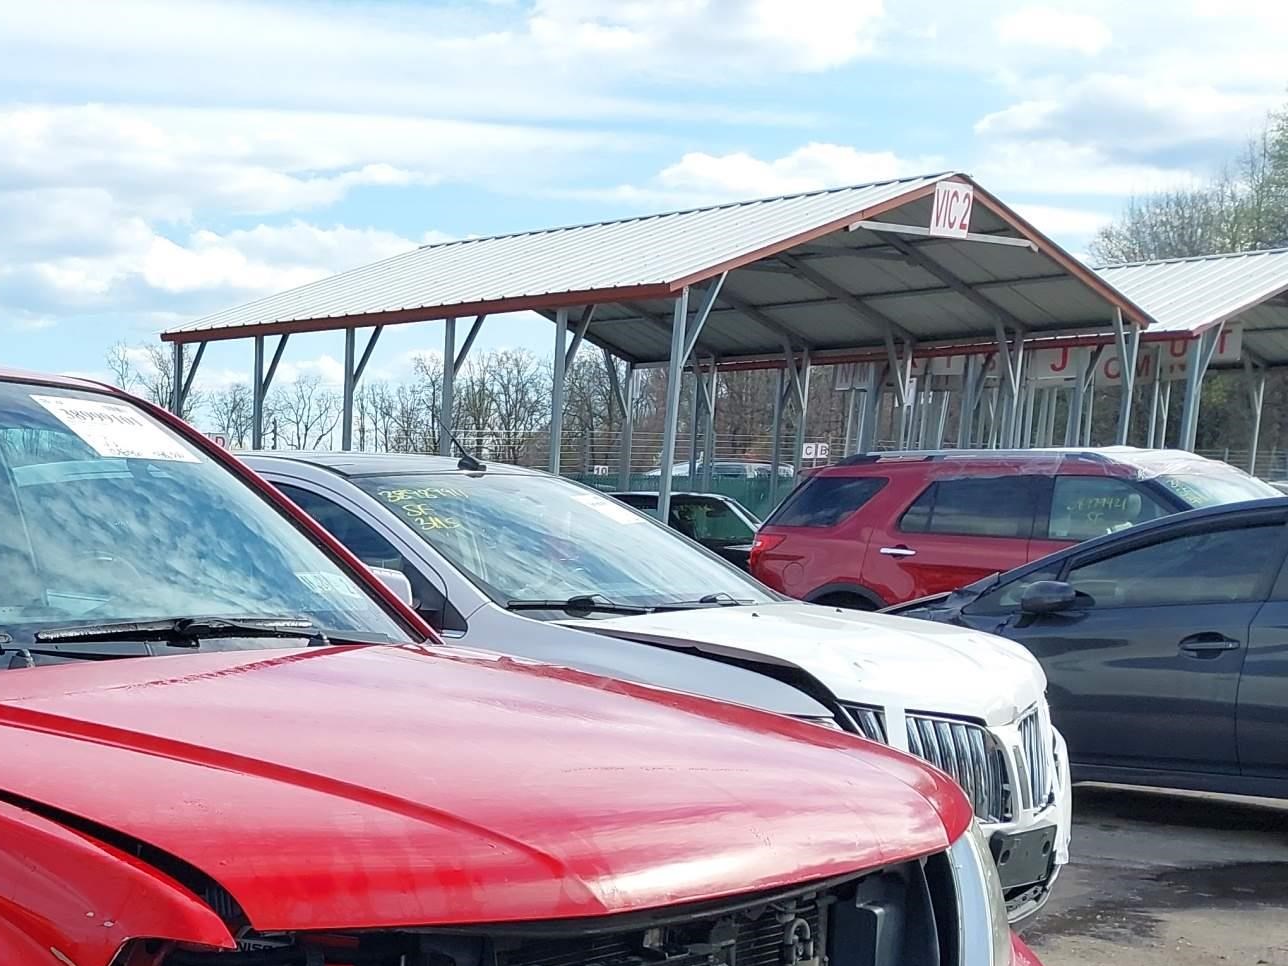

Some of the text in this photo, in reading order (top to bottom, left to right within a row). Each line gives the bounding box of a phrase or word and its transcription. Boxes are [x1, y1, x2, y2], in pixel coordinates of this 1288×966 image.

[935, 188, 971, 230] VIC 2
[594, 466, 609, 476] 10
